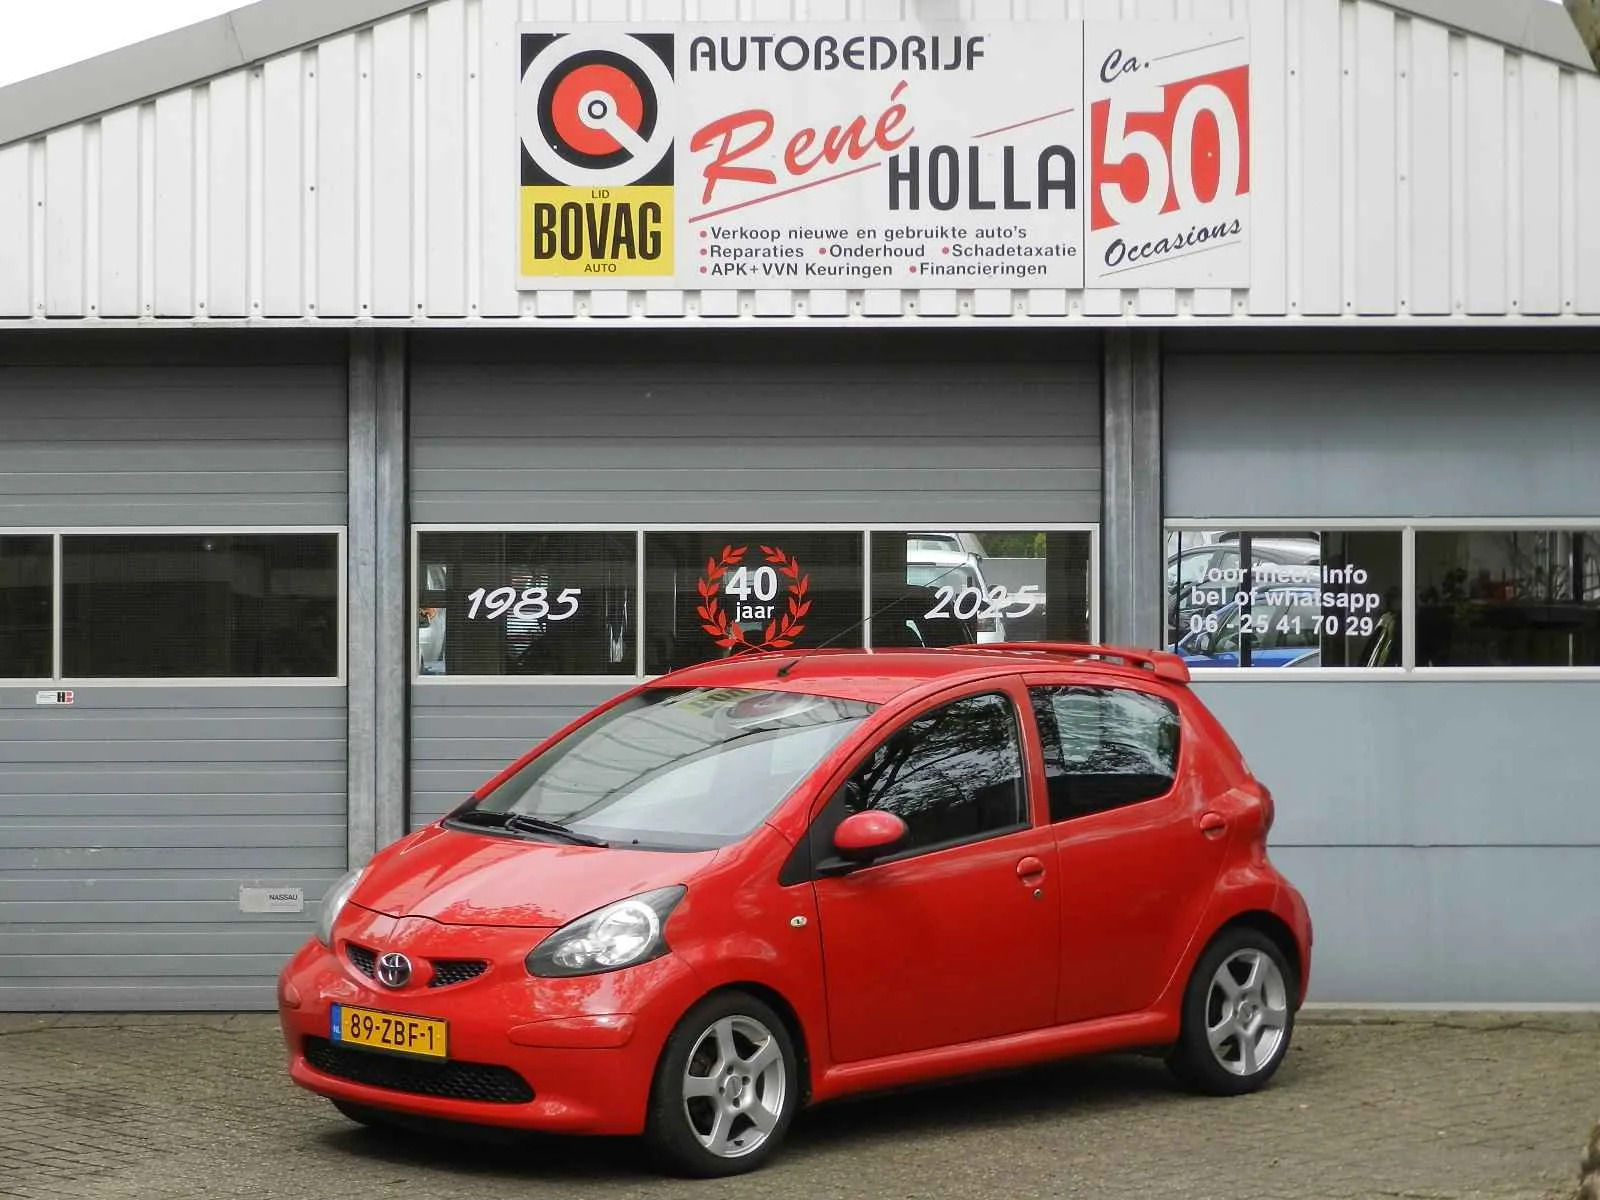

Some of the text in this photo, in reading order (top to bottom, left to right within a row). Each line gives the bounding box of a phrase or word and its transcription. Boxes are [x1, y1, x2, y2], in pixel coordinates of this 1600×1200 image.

[689, 35, 985, 71] AUTOBEDRIJF
[1099, 48, 1150, 84] Ca.
[690, 79, 915, 205] René
[1099, 83, 1241, 227] 50
[888, 145, 1076, 210] HOLLA
[591, 189, 610, 199] LID
[534, 201, 662, 260] BOVAG
[711, 225, 1027, 242] Verkoop nieuwe en gebruikte auto's
[1104, 218, 1242, 267] Occasions
[710, 244, 804, 260] Reparaties
[829, 243, 925, 258] Onderhoud
[952, 243, 1077, 258] Schadetaxatie
[584, 263, 617, 273] AUTO
[805, 262, 893, 278] Keuringen
[920, 261, 1047, 278] Financieringen
[725, 565, 778, 602] 40
[1188, 564, 1248, 583] oor
[1322, 563, 1368, 584] Info
[466, 586, 582, 621] 1985
[923, 584, 1039, 620] 2025
[1191, 585, 1380, 610] bel of whatsapp
[734, 602, 775, 624] jaar
[1190, 613, 1219, 634] 06
[1240, 614, 1269, 634] 25
[1276, 614, 1302, 634] 41
[1312, 615, 1339, 635] 70
[1345, 616, 1374, 636] 29
[350, 1013, 434, 1050] 89-ZBF-1
